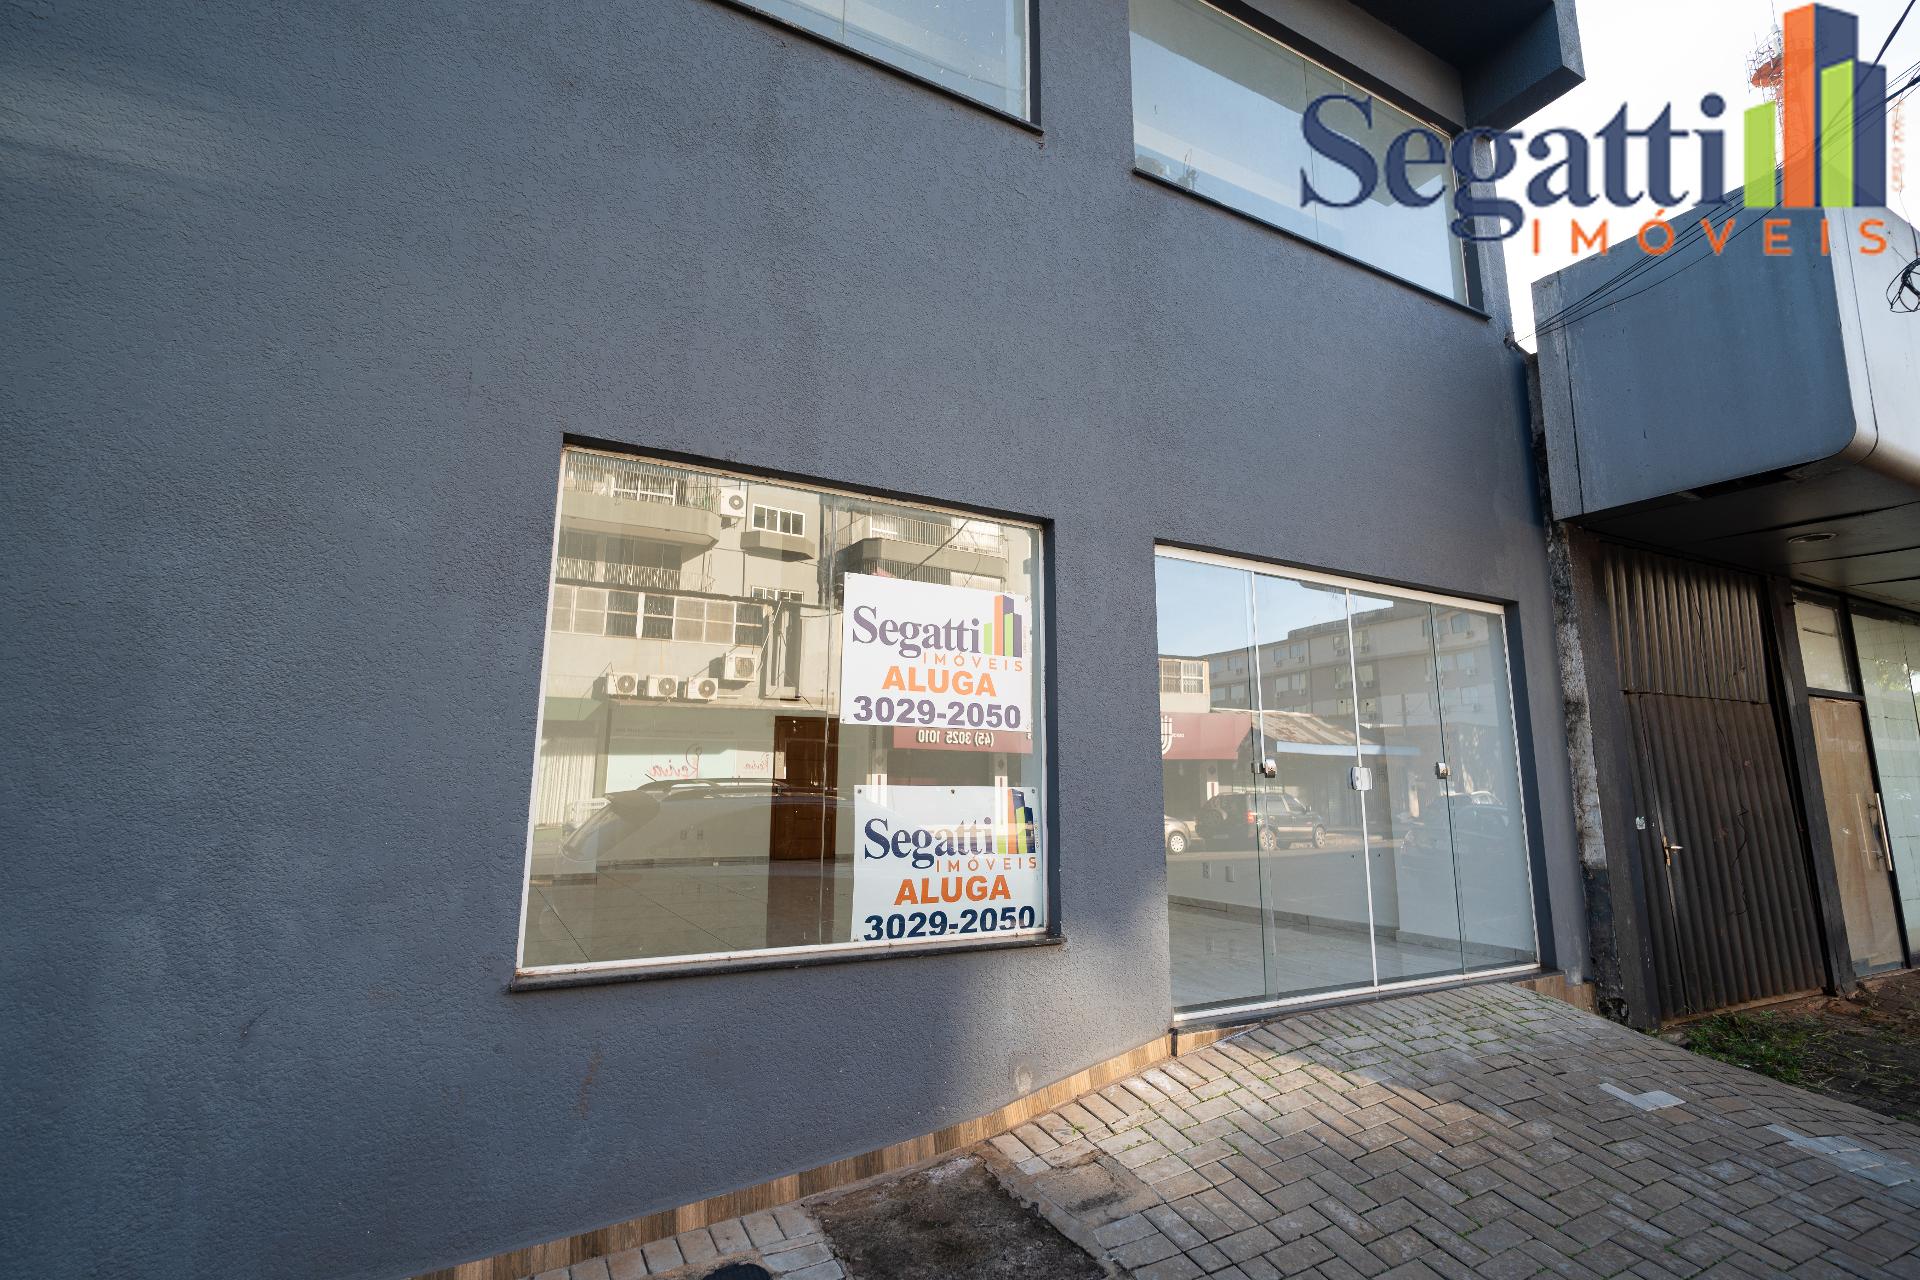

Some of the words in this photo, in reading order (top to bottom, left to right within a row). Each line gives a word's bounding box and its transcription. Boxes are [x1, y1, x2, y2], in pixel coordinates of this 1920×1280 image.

[852, 605, 981, 658] Segatti
[923, 652, 1023, 672] IMÓVEIS
[881, 665, 997, 697] ALUGA
[853, 695, 1021, 729] 3029-2050
[864, 816, 995, 869] Segatti
[936, 856, 1037, 873] IMÓVEIS
[894, 874, 1011, 906] ALUGA
[863, 905, 1035, 941] 3029-2050
